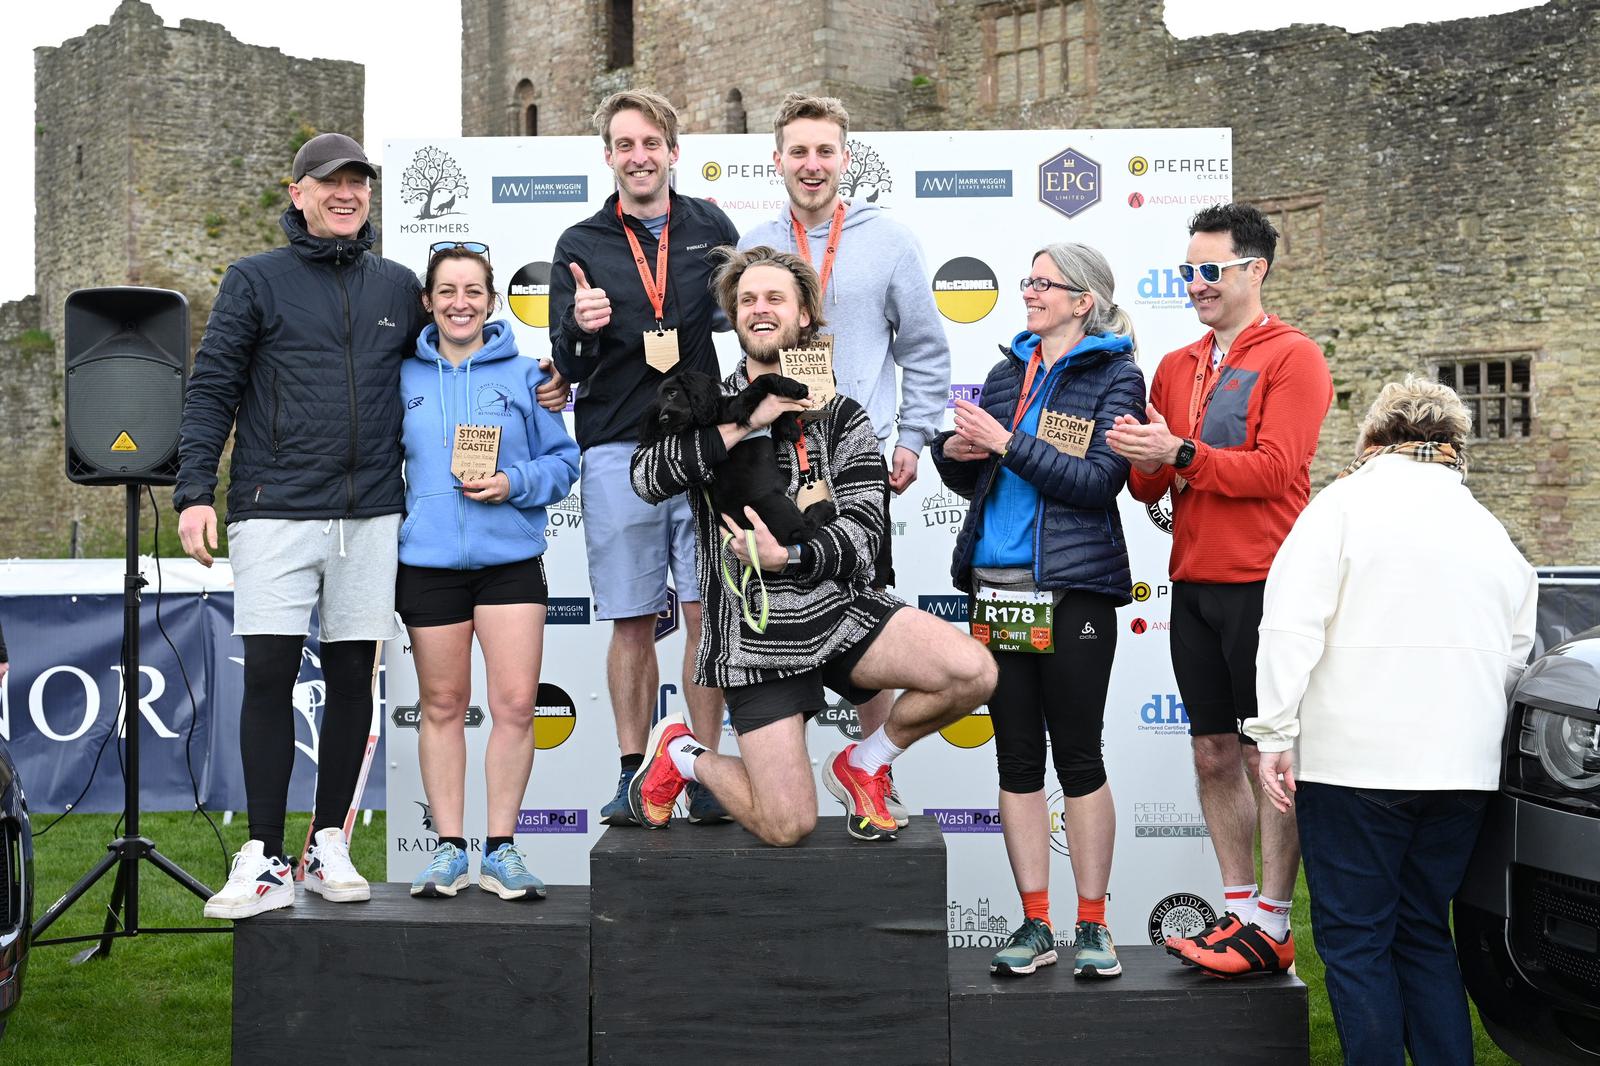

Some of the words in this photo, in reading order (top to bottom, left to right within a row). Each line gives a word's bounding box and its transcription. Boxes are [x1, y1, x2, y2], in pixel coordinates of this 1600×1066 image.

[728, 165, 776, 178] PEAR
[1154, 158, 1229, 173] PEARCE
[1046, 172, 1094, 192] EPG
[1149, 195, 1186, 205] ANDALI
[1190, 195, 1230, 204] EVENTS
[400, 224, 469, 234] MORTIMERS
[785, 354, 826, 363] STORM
[791, 367, 828, 375] CASTLE
[1045, 415, 1089, 433] STORM
[459, 429, 496, 440] STORM
[1046, 430, 1086, 446] CASTLE
[461, 442, 494, 452] CASTLE
[923, 510, 962, 527] LUD
[985, 605, 1035, 623] R178
[1134, 803, 1176, 812] PETER
[934, 812, 1001, 825] WashPod
[1134, 813, 1200, 822] MEREDITH
[1153, 901, 1172, 923] THE
[1173, 896, 1214, 924] LUDLOW
